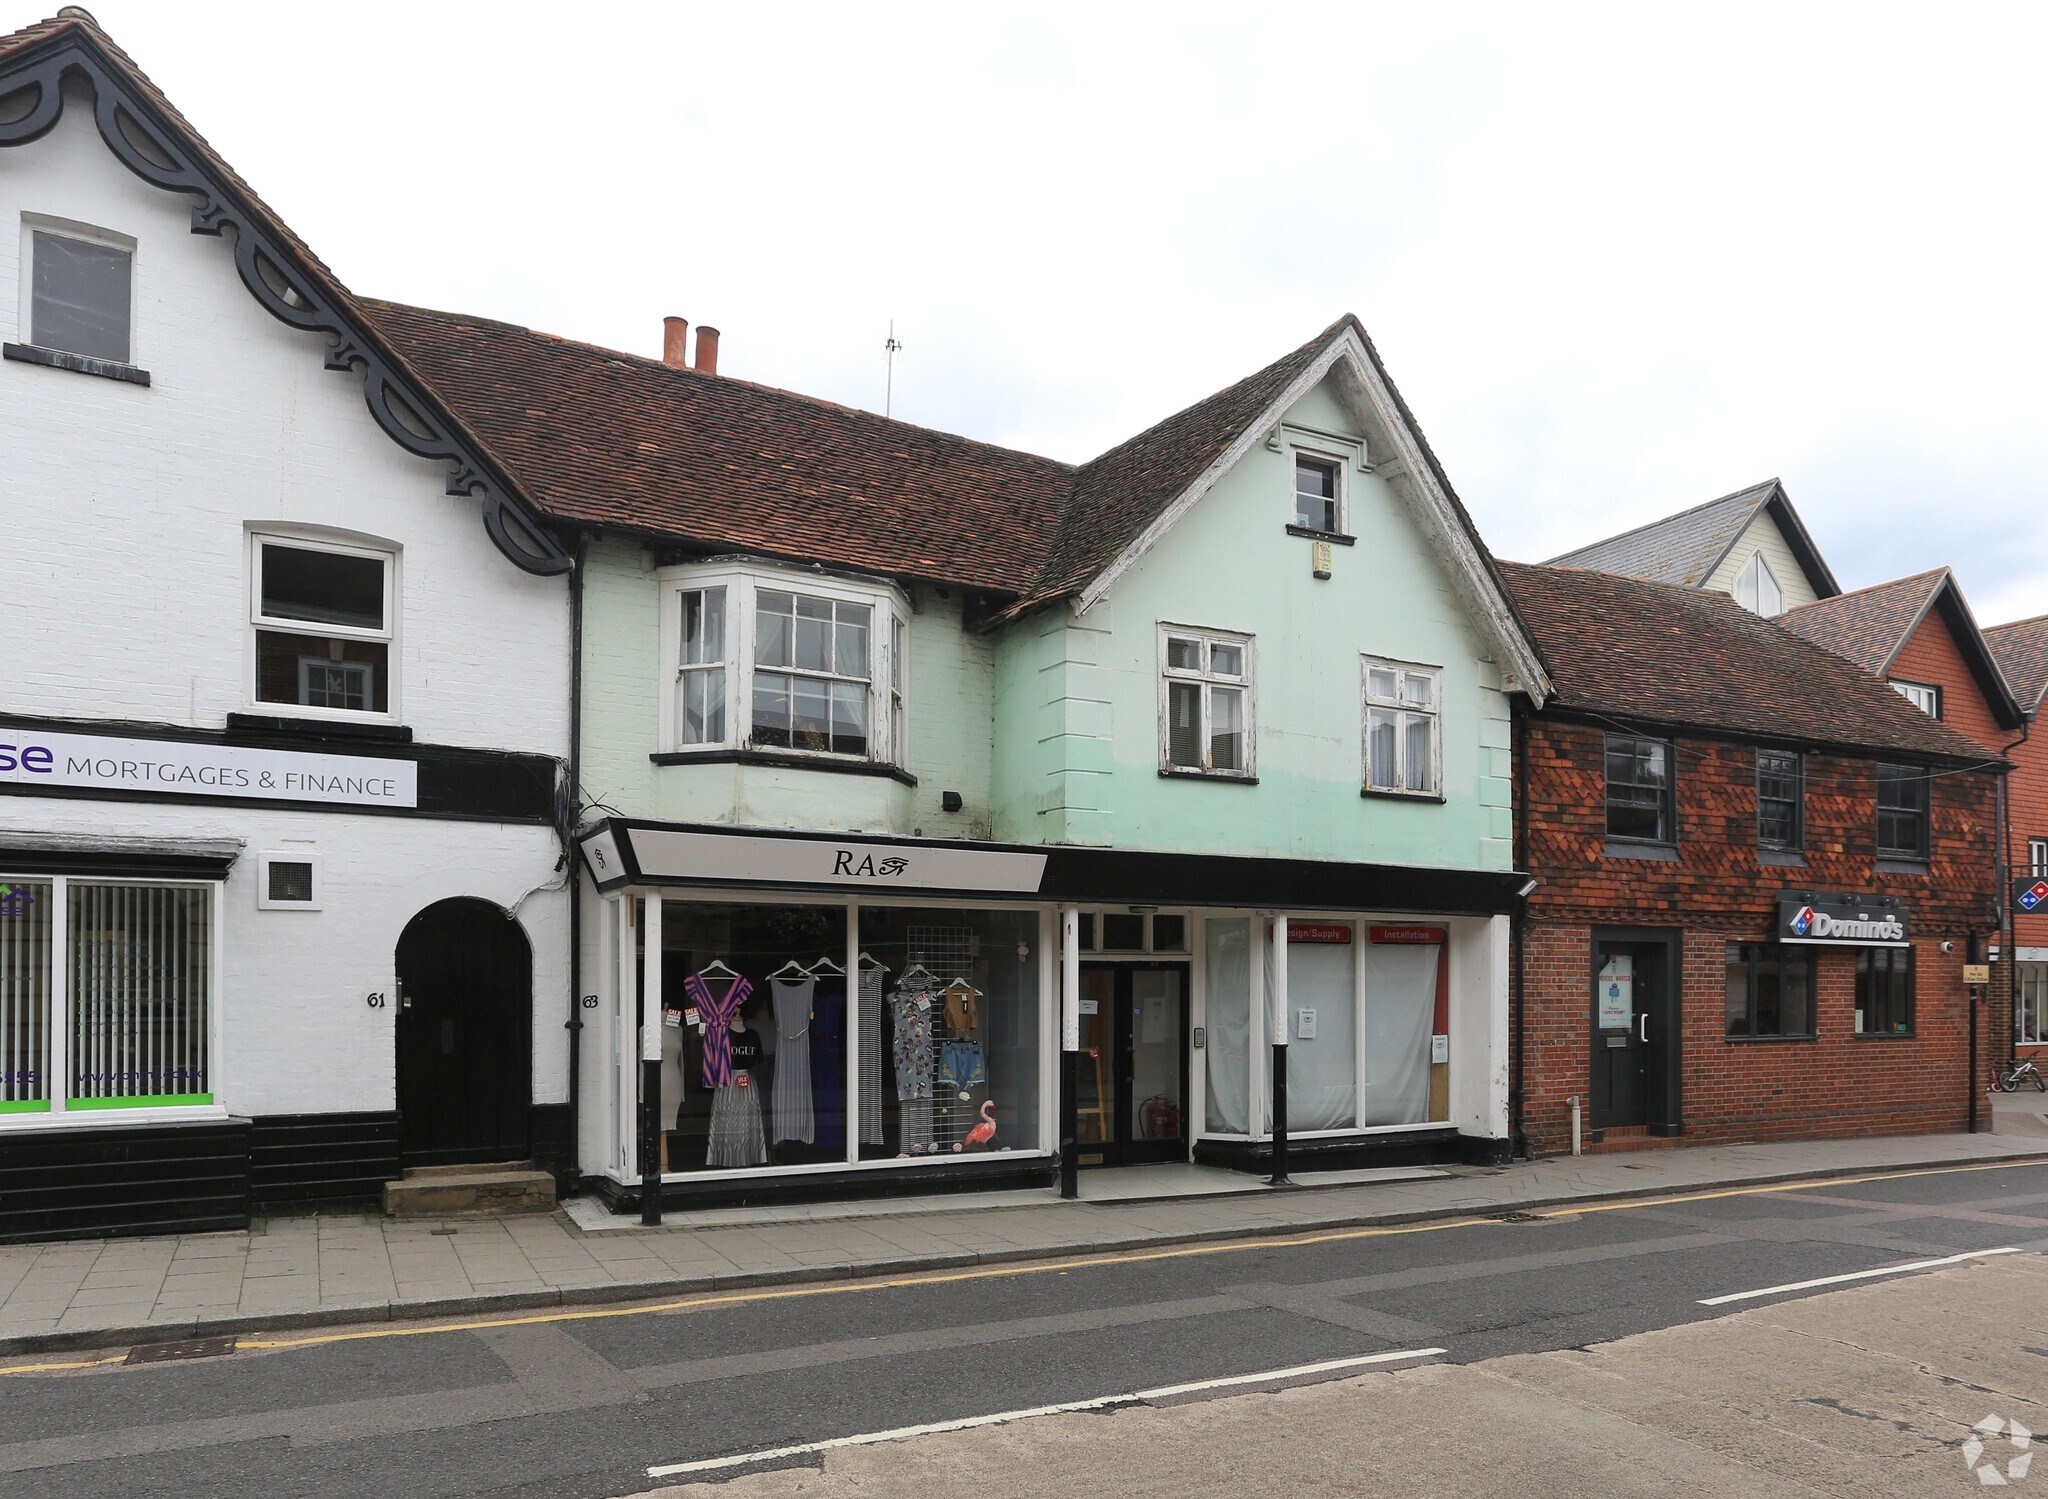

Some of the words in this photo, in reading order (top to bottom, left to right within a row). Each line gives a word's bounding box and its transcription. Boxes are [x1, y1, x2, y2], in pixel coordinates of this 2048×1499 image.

[66, 757, 249, 787] MORTGAGES
[258, 770, 276, 789] &
[285, 772, 396, 797] FINANCE
[831, 849, 877, 877] RA
[1384, 930, 1429, 939] Installation
[1811, 912, 1903, 939] Domino's
[367, 993, 385, 1008] 61
[583, 995, 598, 1008] 63
